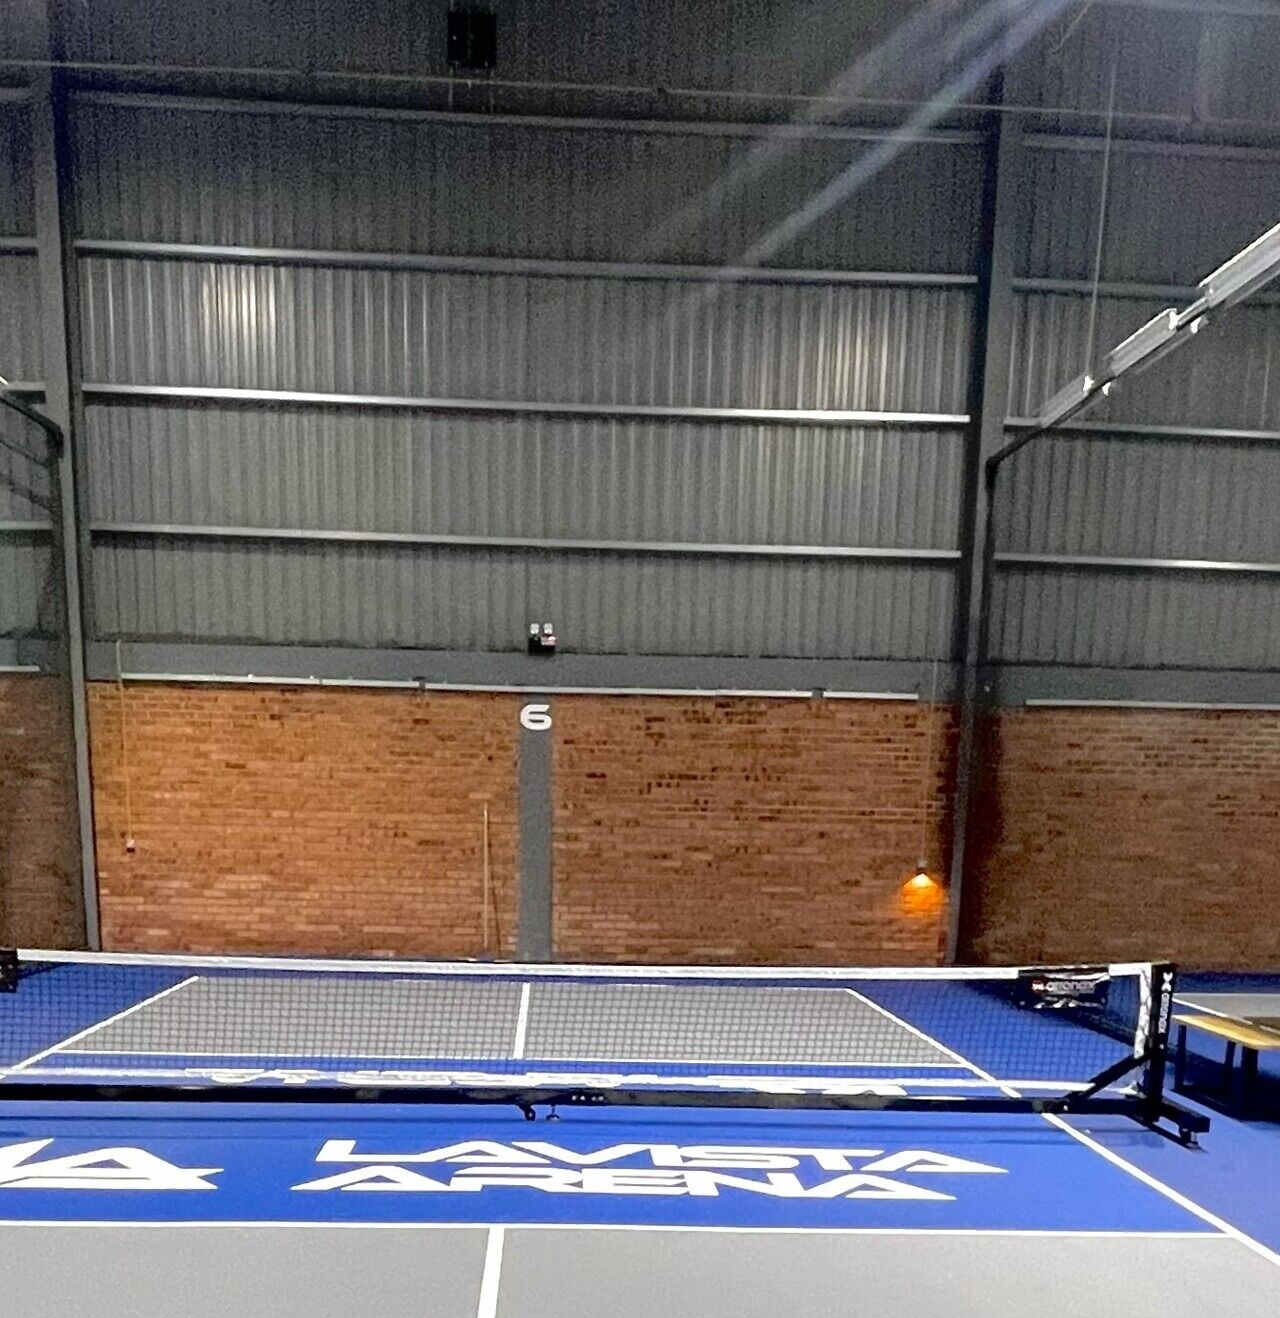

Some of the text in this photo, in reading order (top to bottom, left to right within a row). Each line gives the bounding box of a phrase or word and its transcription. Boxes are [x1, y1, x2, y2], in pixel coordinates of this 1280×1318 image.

[520, 704, 552, 731] 6
[315, 1139, 1009, 1173] LAVISTA
[290, 1164, 957, 1201] ARENA
